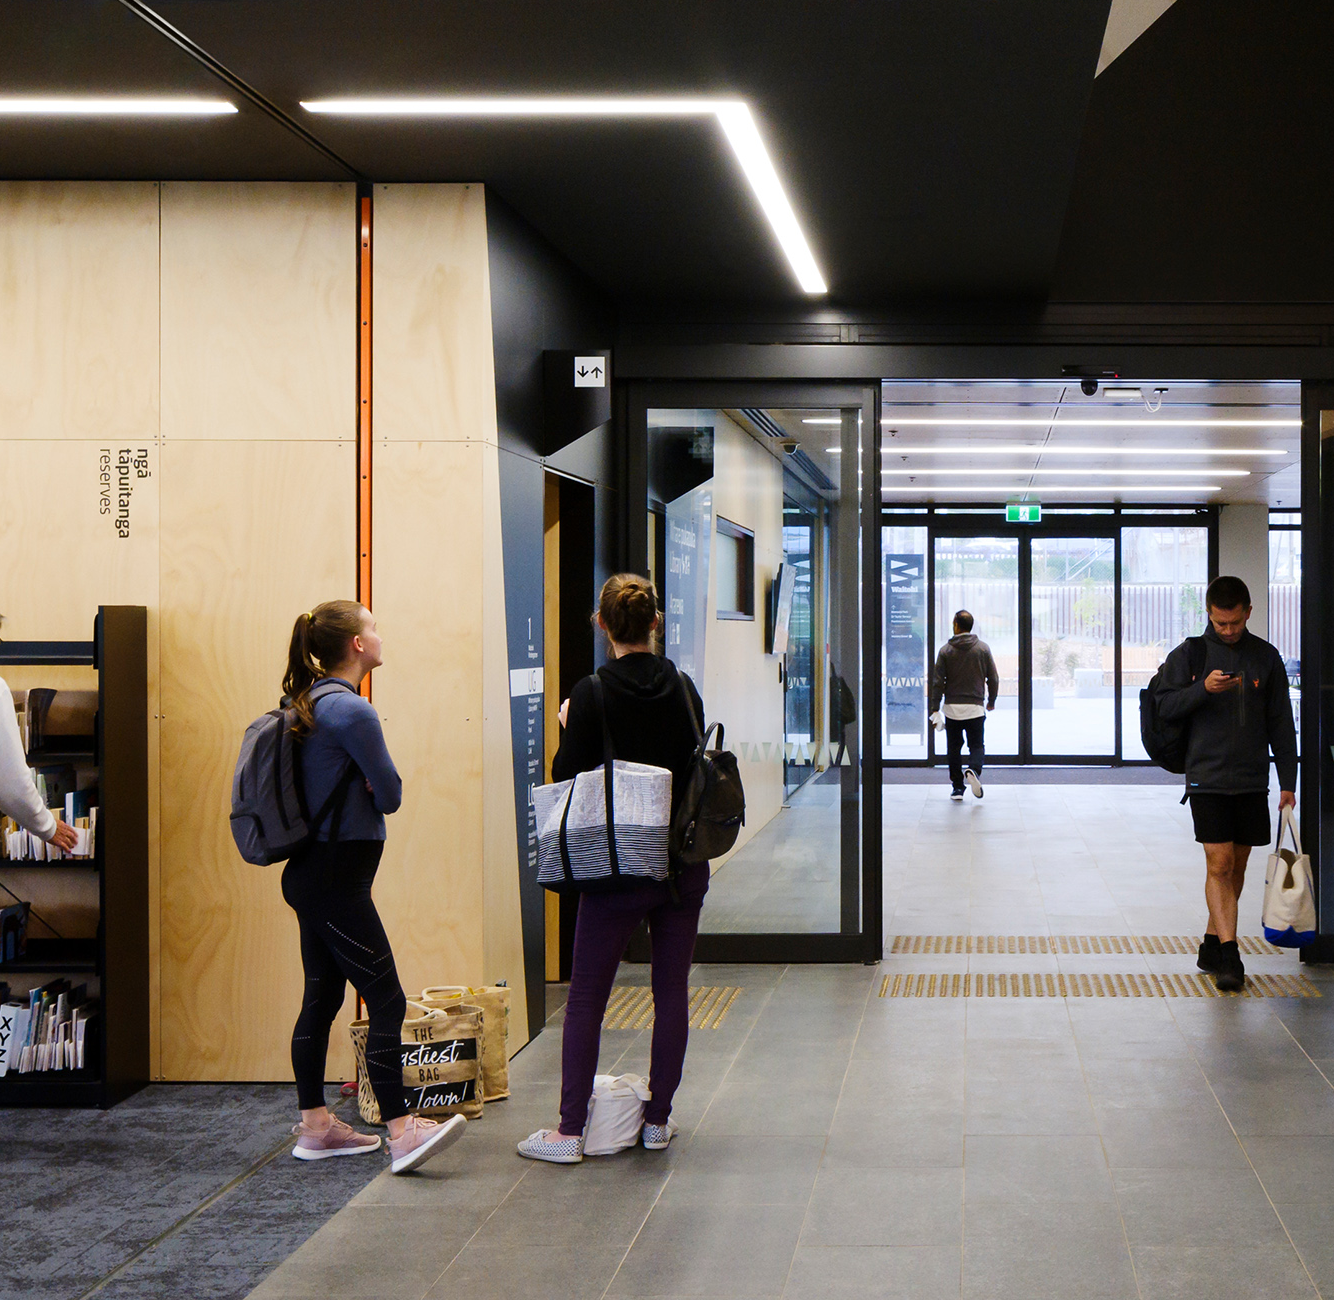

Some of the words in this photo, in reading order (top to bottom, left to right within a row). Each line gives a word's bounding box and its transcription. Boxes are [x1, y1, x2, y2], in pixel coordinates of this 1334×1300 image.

[133, 448, 151, 478] ngā
[99, 448, 111, 515] reserves
[115, 448, 133, 538] tāpuitanga
[0, 1016, 13, 1031] X
[413, 1026, 434, 1042] THE
[401, 1040, 464, 1067] astiest
[419, 1067, 440, 1082] BAG
[413, 1081, 468, 1110] Town!
